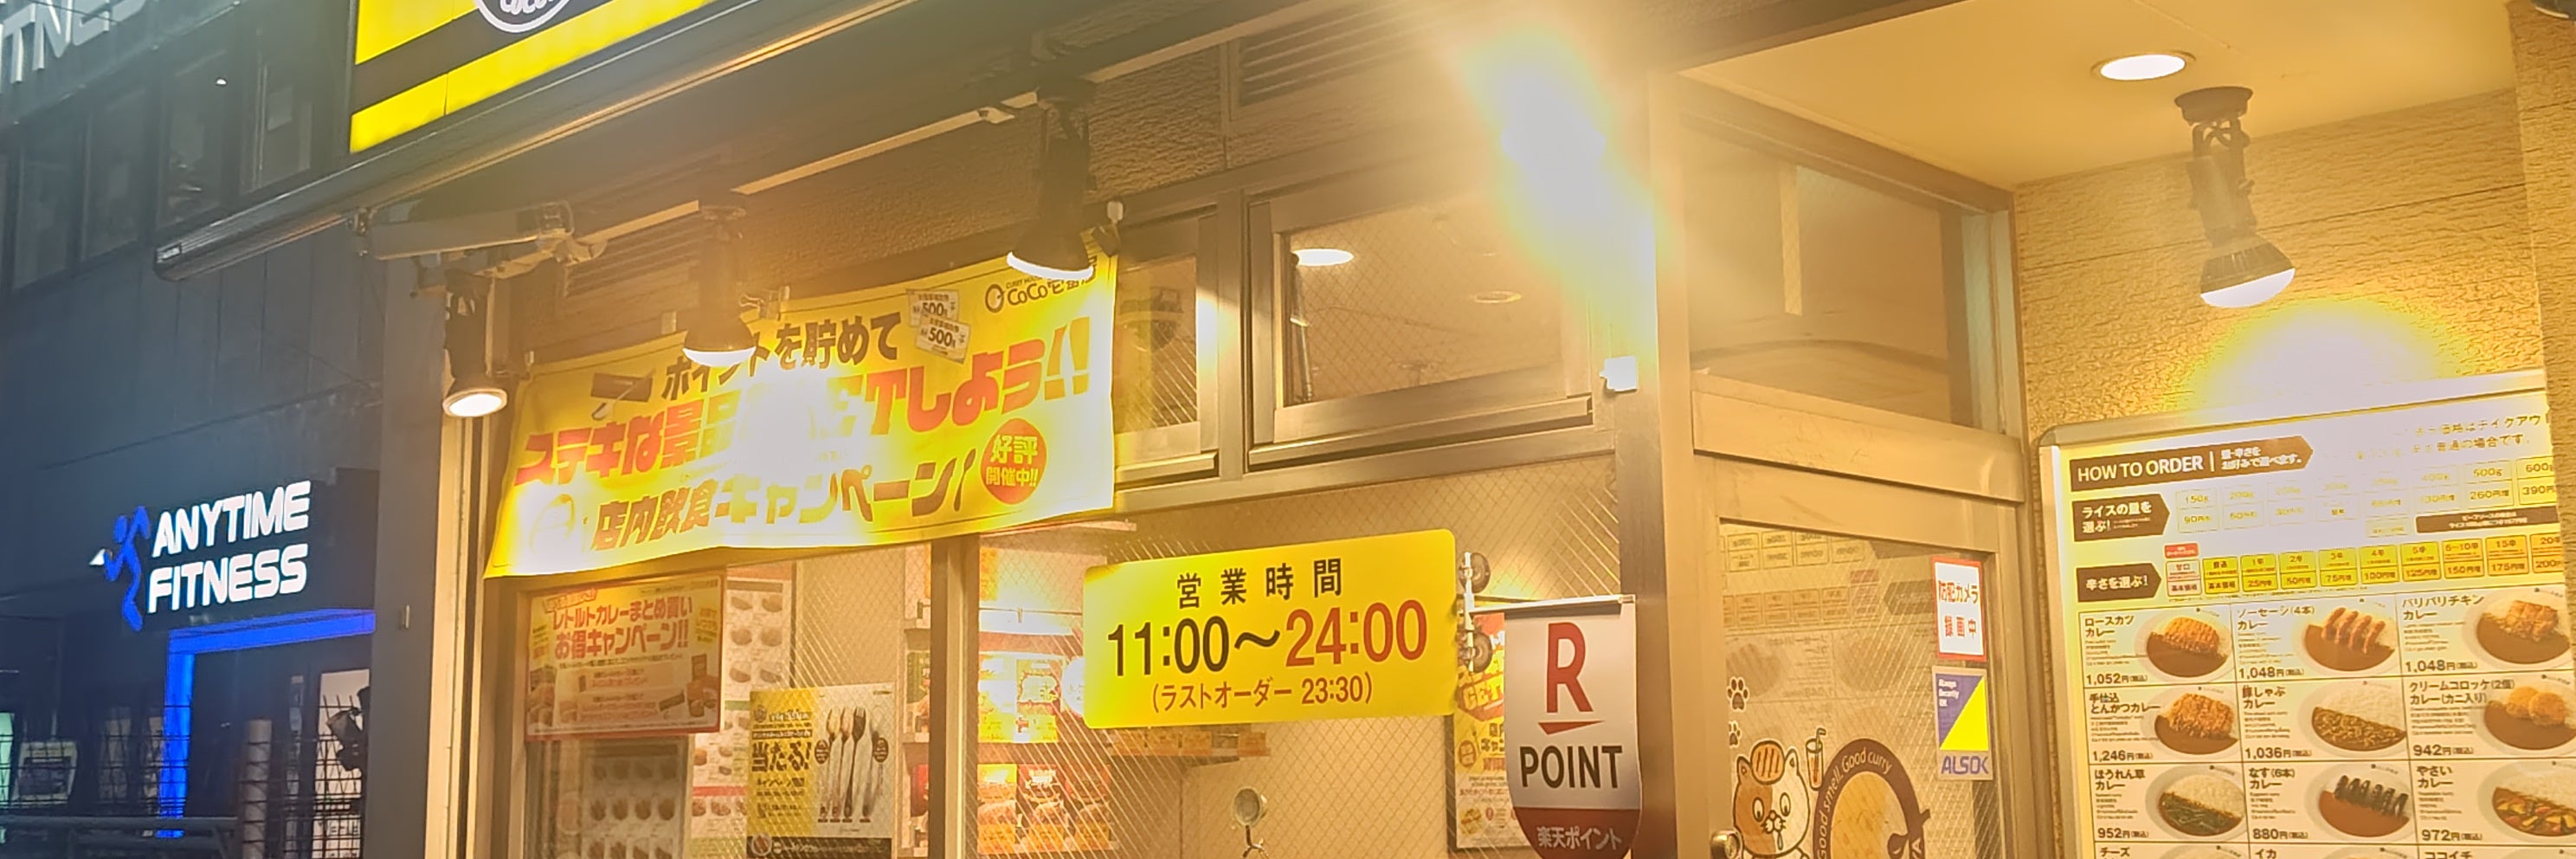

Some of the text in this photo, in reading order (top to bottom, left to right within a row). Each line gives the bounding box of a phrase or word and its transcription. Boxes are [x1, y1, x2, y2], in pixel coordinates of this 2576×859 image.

[991, 435, 1038, 465] 好評
[2077, 455, 2204, 482] HOW TO ORDER
[151, 481, 312, 557] ANYTIME
[2082, 501, 2152, 517] ライスの量を
[147, 543, 309, 614] FITNESS
[1176, 558, 1343, 610] 営業時間
[552, 596, 692, 630] レトルトカレーまとめ買い
[2403, 610, 2438, 621] カレー
[2084, 627, 2116, 638] カレー
[2238, 620, 2269, 630] カレー
[555, 619, 689, 660] お得キャンペーン!!
[1546, 622, 1594, 714] R
[1301, 670, 1373, 706] 23:30)
[2090, 702, 2161, 714] とんかつカレー
[2244, 699, 2276, 709] カレー
[1519, 745, 1623, 790] POINT
[1842, 746, 1867, 772] Good
[1867, 752, 1893, 775] curry
[1941, 755, 1989, 775] ALSOK
[2094, 769, 2146, 780] ほうれん草
[2417, 765, 2453, 777] やさい
[2095, 780, 2126, 791] カレー
[2250, 779, 2283, 790] カレー
[2418, 778, 2454, 789] カレー
[1536, 825, 1622, 850] 楽天ポイント
[2100, 846, 2131, 857] チーズ
